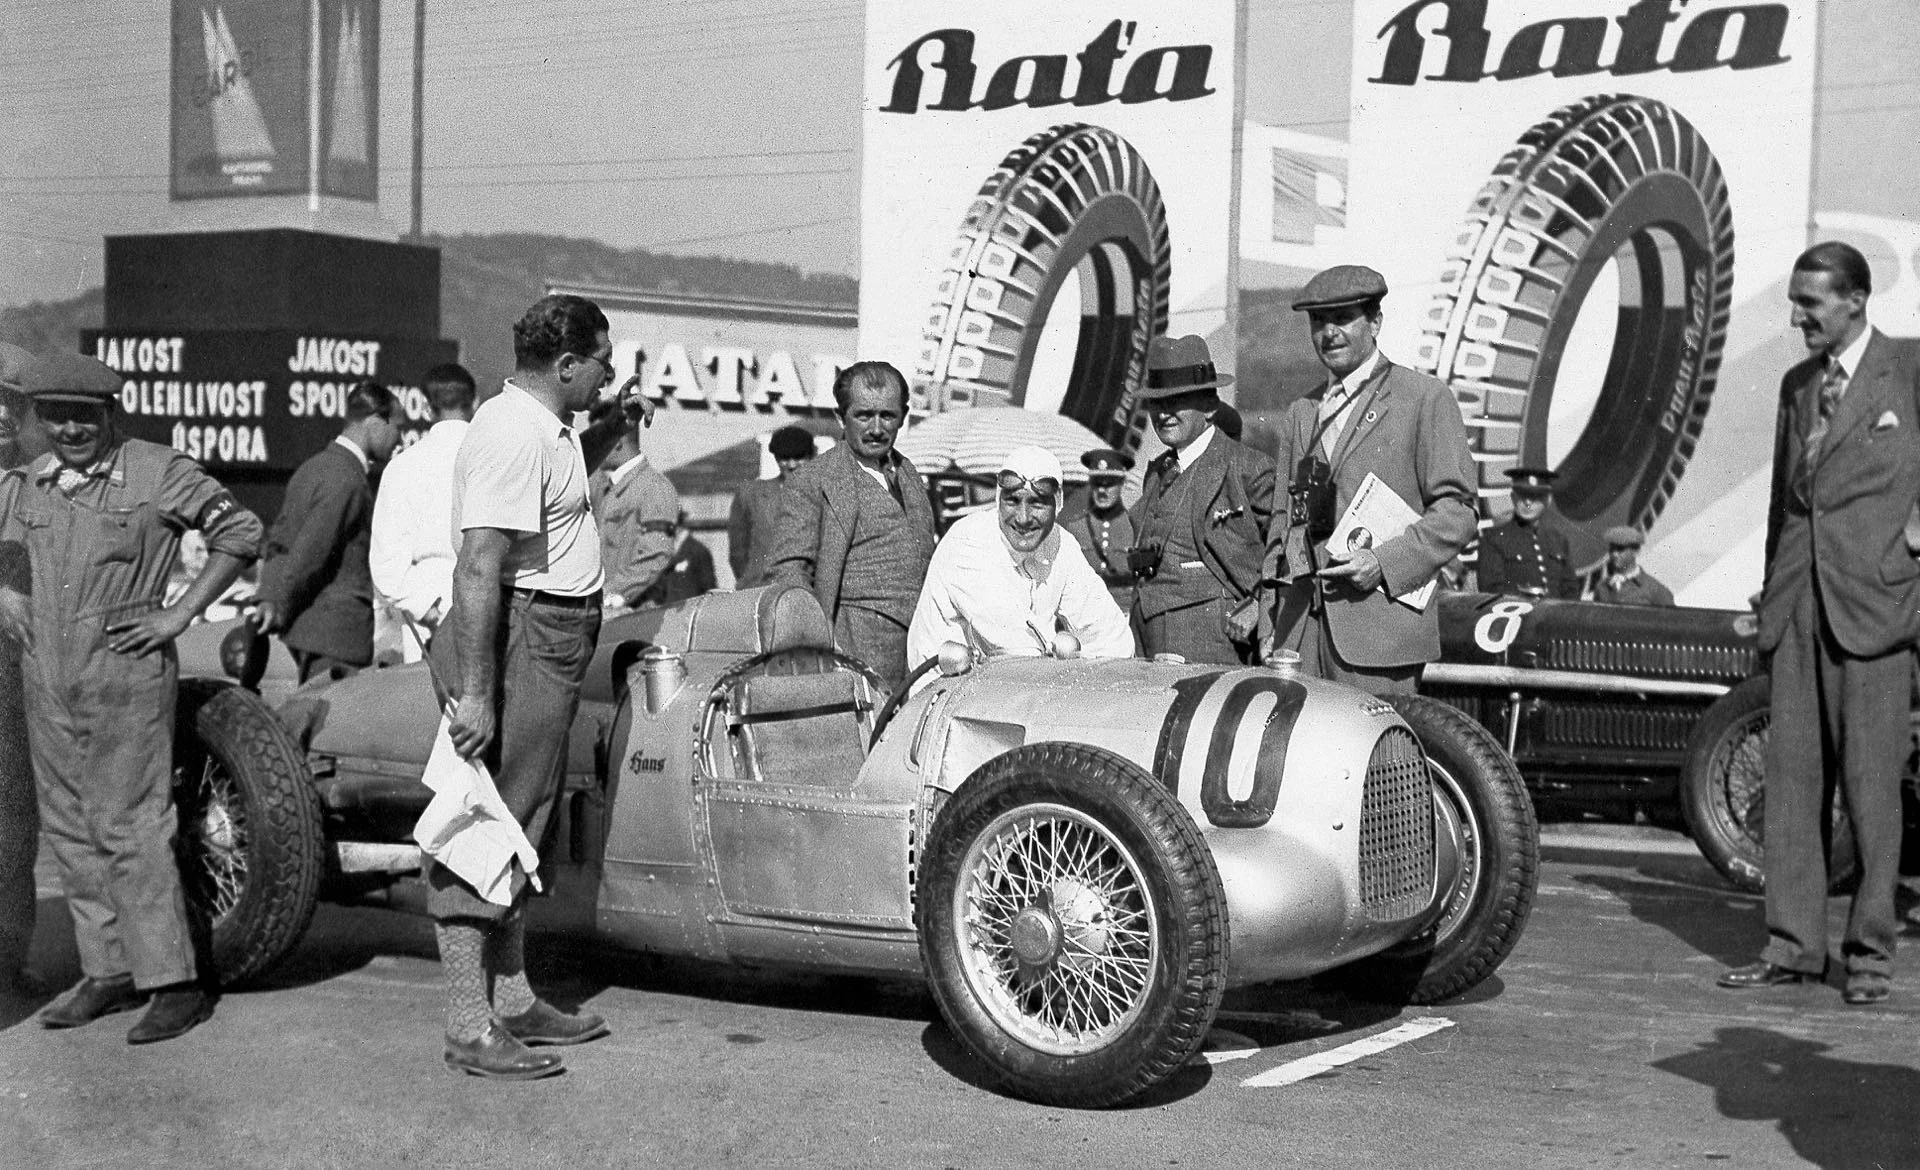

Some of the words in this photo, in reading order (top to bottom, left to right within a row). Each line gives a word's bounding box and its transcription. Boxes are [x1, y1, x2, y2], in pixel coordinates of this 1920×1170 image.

[288, 337, 380, 376] JAKOST
[112, 380, 266, 417] OLEHLIVOST
[1474, 601, 1534, 653] 8
[629, 750, 666, 775] Hans
[1152, 671, 1308, 829] 10
